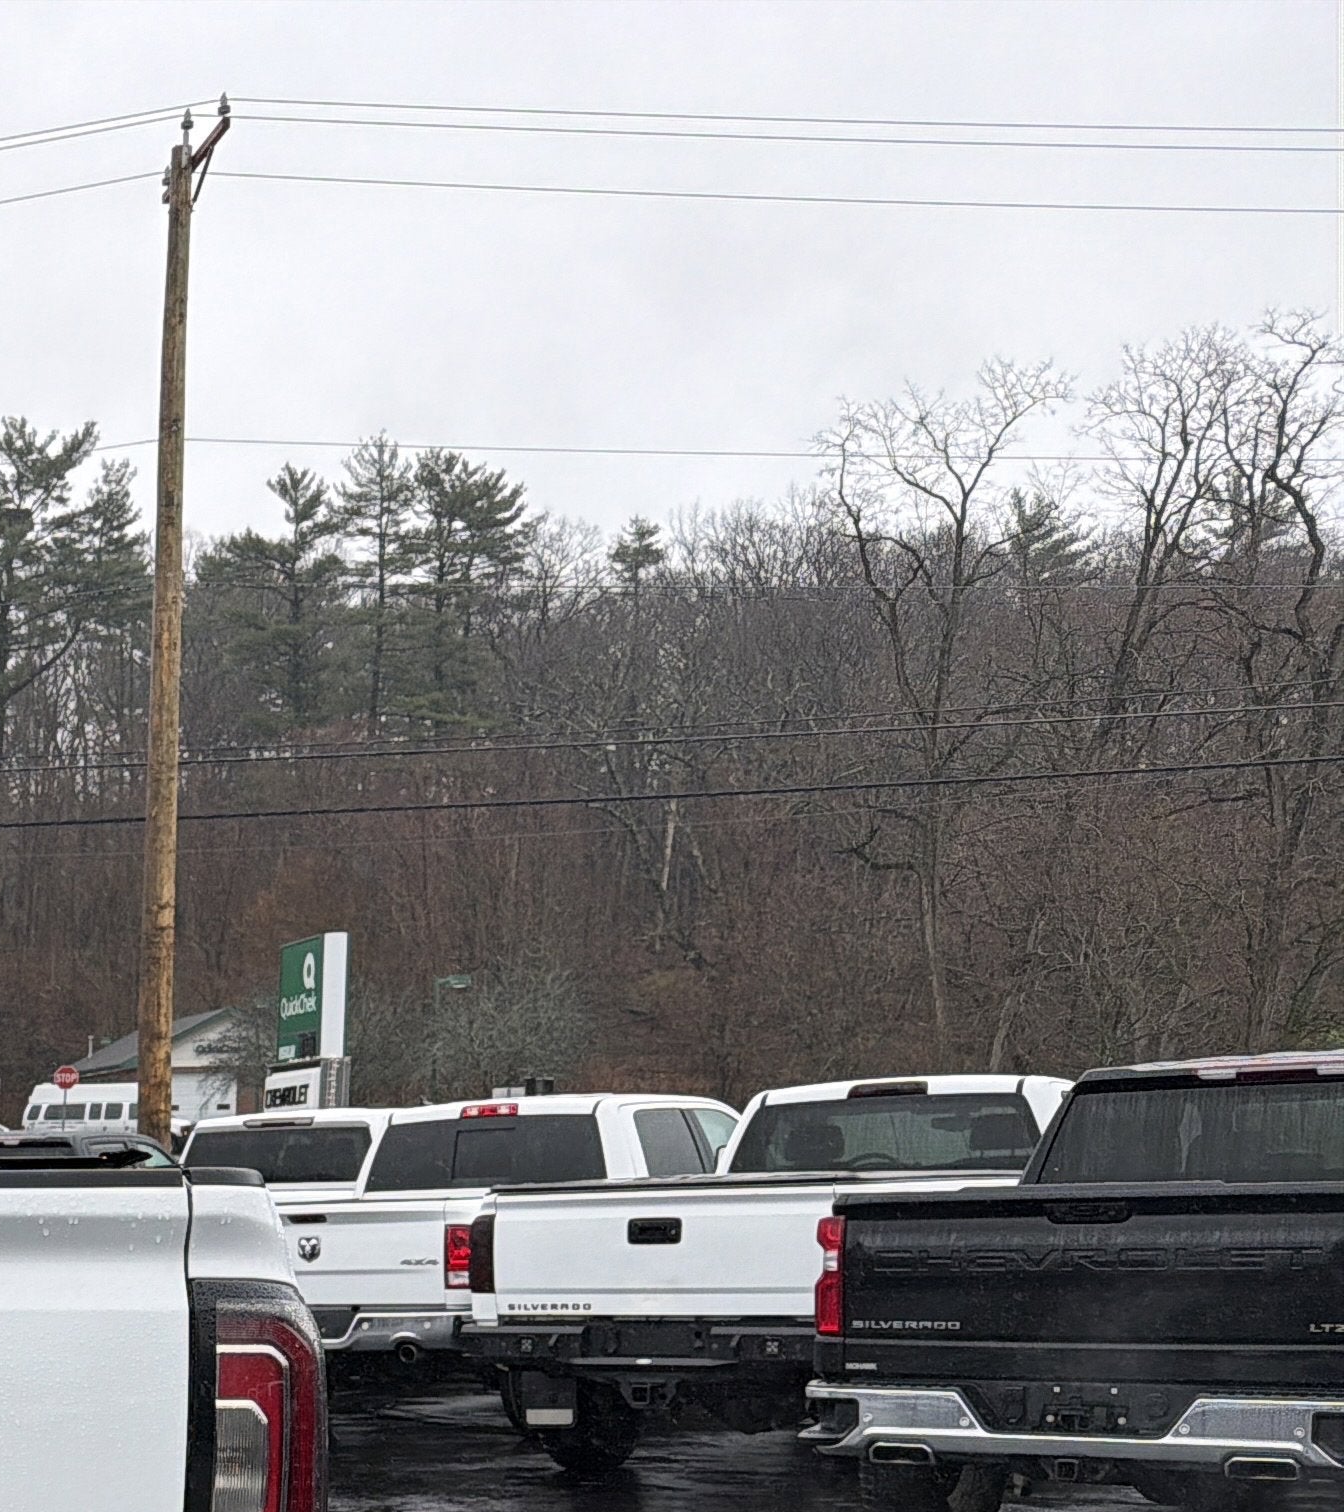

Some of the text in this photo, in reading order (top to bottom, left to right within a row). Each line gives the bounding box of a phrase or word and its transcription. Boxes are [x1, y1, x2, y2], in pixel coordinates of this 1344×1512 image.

[280, 990, 317, 1021] QuickChek
[55, 1072, 79, 1084] STOP
[873, 1246, 1323, 1272] CHEVROLET
[507, 1302, 592, 1311] SILVERADO
[851, 1319, 961, 1330] SILVERADO
